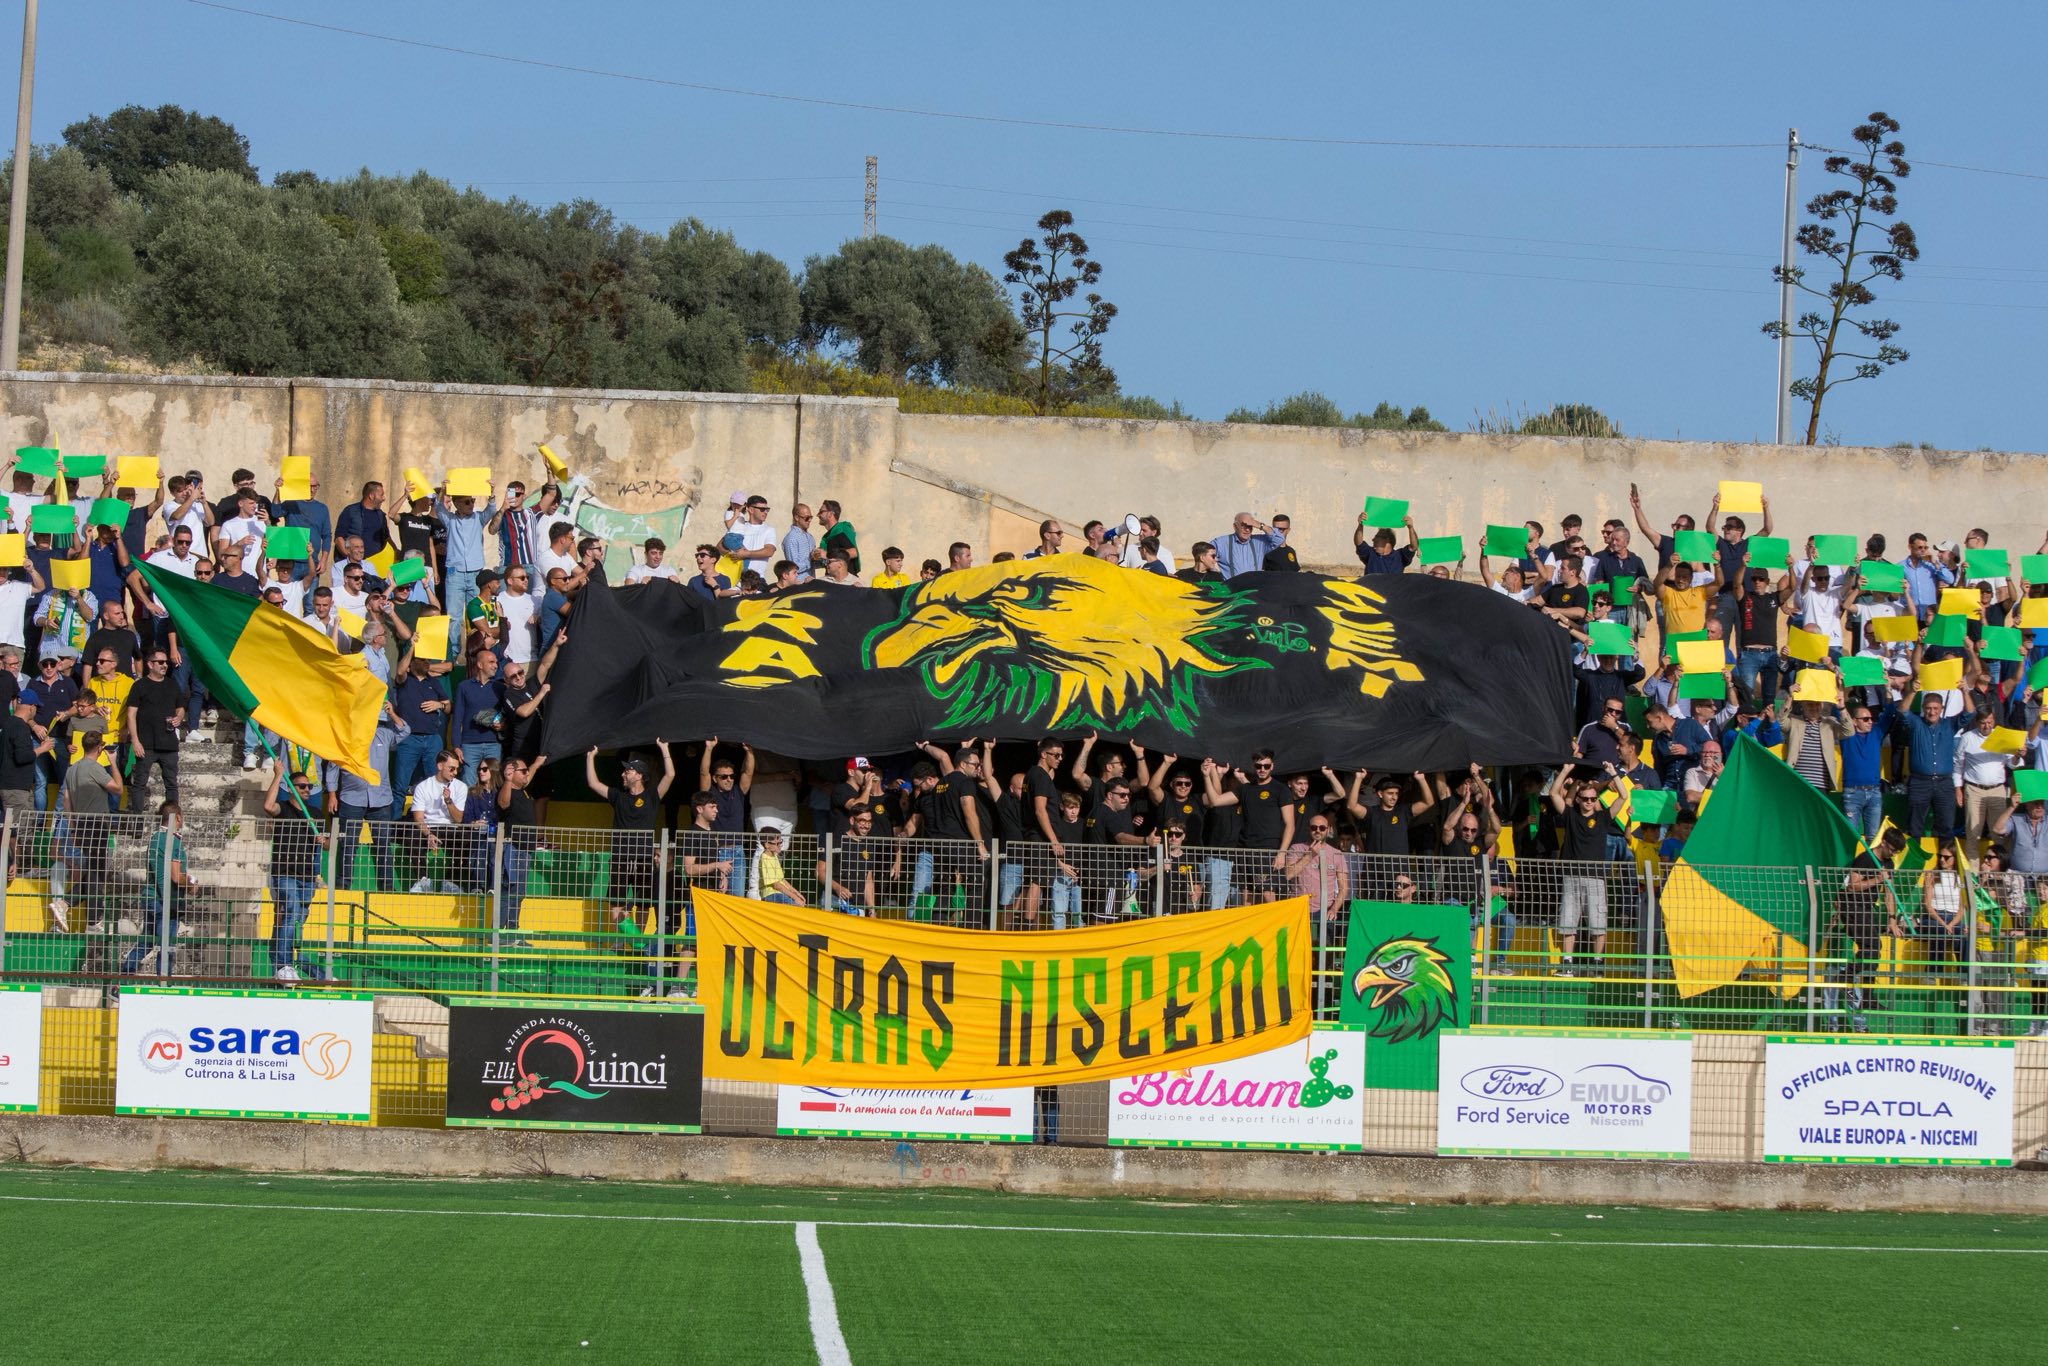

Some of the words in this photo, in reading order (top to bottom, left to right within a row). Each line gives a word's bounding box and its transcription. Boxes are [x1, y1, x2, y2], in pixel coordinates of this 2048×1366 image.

[718, 933, 955, 1072] ULTRAS
[996, 926, 1294, 1068] NISCEMI
[188, 1026, 300, 1056] sara
[505, 1017, 546, 1053] AZIENDA
[549, 1017, 597, 1056] AGRICOLA
[194, 1057, 232, 1068] agenzia
[235, 1057, 245, 1067] di
[248, 1058, 288, 1068] Niscemi
[482, 1061, 516, 1079] F.lli
[184, 1067, 234, 1080] Cutrona
[238, 1069, 247, 1080] &
[251, 1069, 266, 1081] La
[269, 1070, 296, 1081] Lisa
[1482, 1069, 1548, 1096] Ford
[1781, 1060, 1853, 1101] OFFICINA
[1856, 1057, 1916, 1074] CENTRO
[1919, 1060, 1997, 1101] REVISIONE
[1570, 1083, 1666, 1103] EMULO
[838, 1102, 852, 1113] In
[854, 1104, 897, 1115] armonia
[899, 1107, 917, 1115] con
[919, 1105, 933, 1116] la
[935, 1106, 973, 1117] Natura
[1457, 1106, 1500, 1125] Ford
[1506, 1107, 1570, 1126] Service
[1584, 1103, 1652, 1116] MOTORS
[1824, 1099, 1953, 1118] SPATOLA
[1117, 1112, 1192, 1122] produzione
[1199, 1113, 1215, 1123] ed
[1221, 1114, 1264, 1125] export
[1271, 1115, 1300, 1125] fichi
[1307, 1115, 1354, 1126] d'india
[1590, 1115, 1644, 1127] Niscemi
[1799, 1127, 1841, 1144] VIALE
[1845, 1128, 1906, 1145] EUROPA
[1920, 1129, 1978, 1146] NISCEMI
